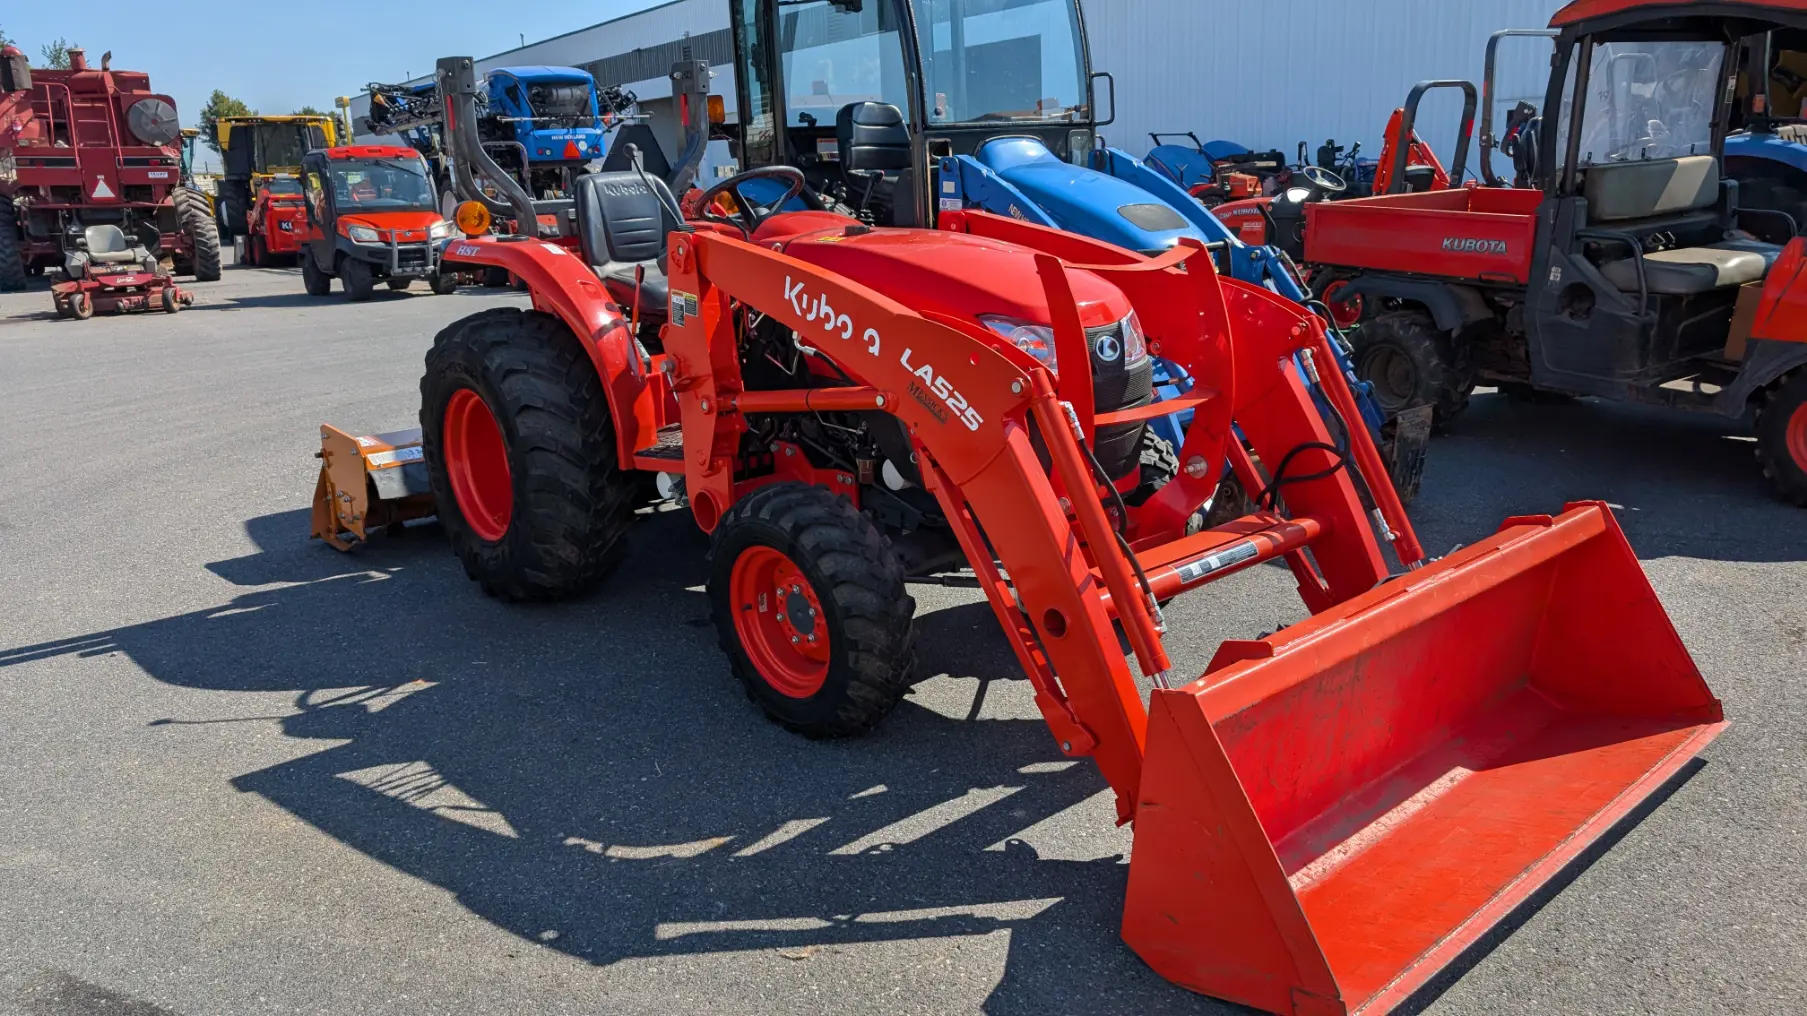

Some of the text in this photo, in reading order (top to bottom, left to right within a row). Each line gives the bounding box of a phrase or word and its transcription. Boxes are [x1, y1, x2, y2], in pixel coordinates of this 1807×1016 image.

[456, 245, 480, 256] HST
[1442, 237, 1507, 254] KUBOTA
[900, 347, 984, 431] LA525
